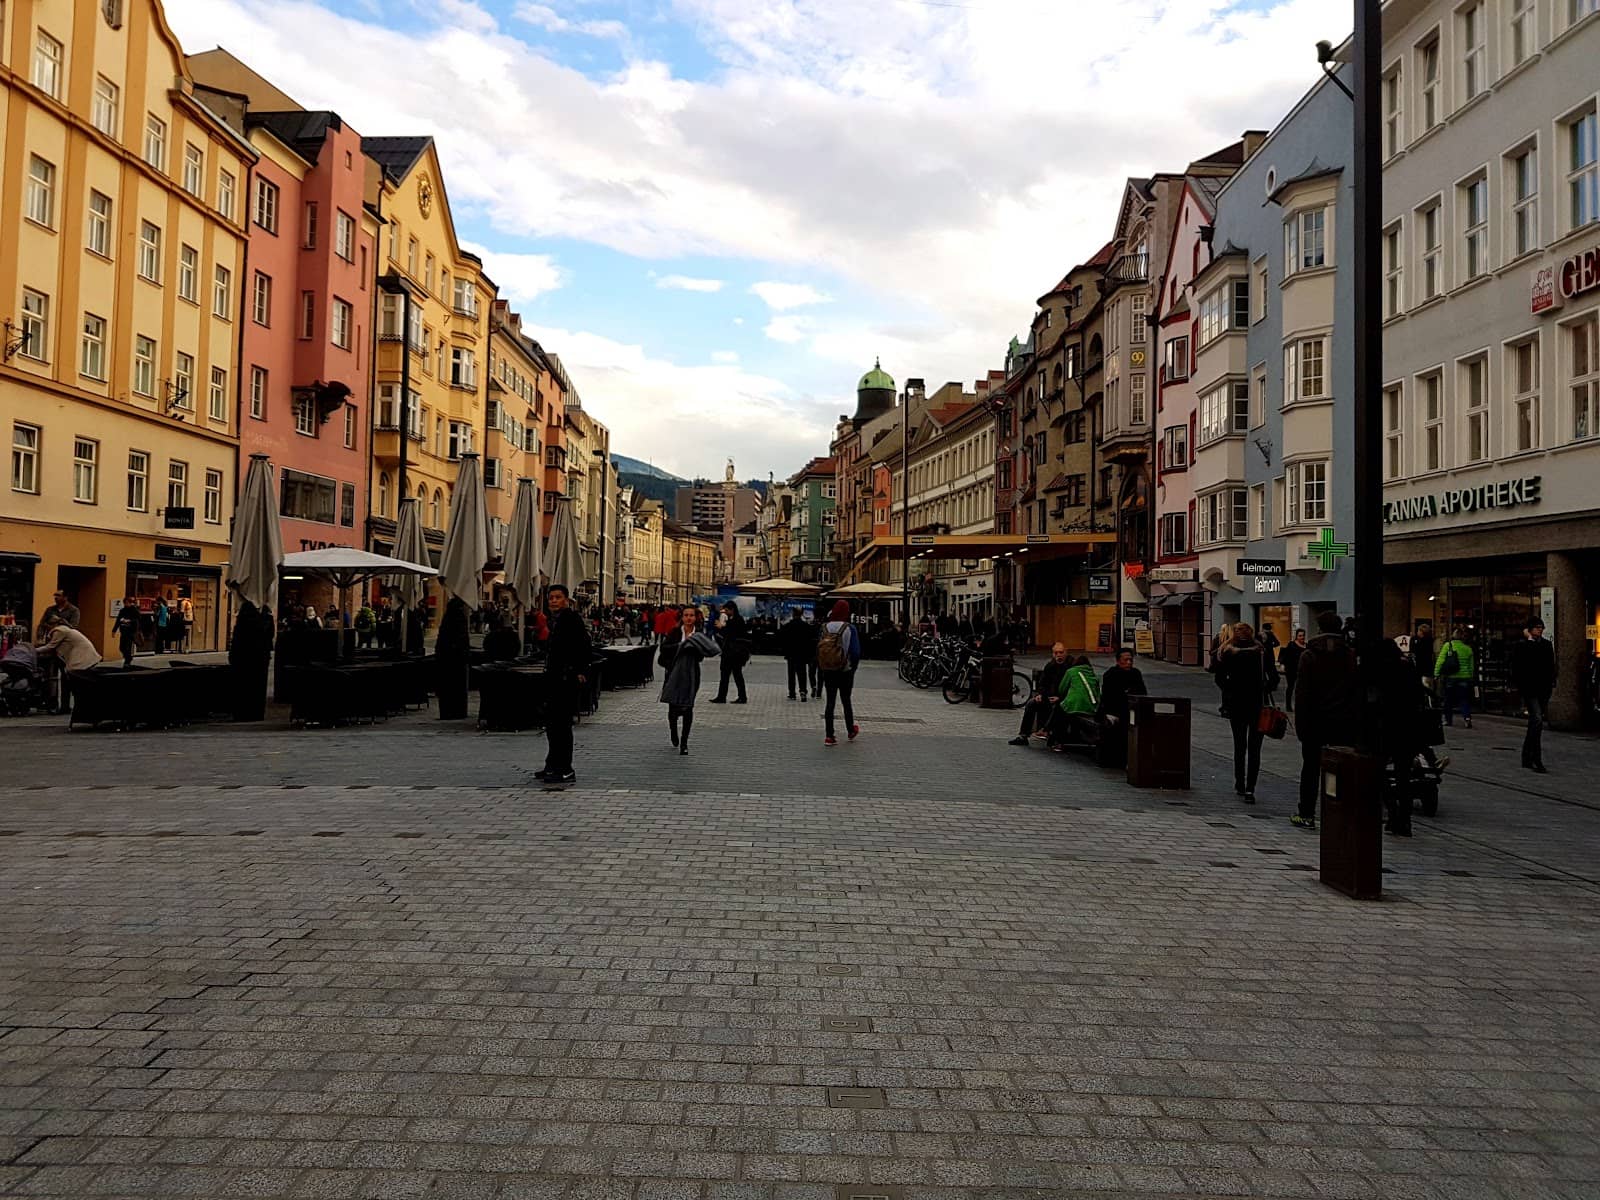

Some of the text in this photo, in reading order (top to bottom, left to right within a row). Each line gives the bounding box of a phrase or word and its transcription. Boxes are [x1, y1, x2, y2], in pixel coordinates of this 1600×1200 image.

[1559, 245, 1600, 298] GE
[1389, 476, 1547, 522] ANNA APOTHEKE
